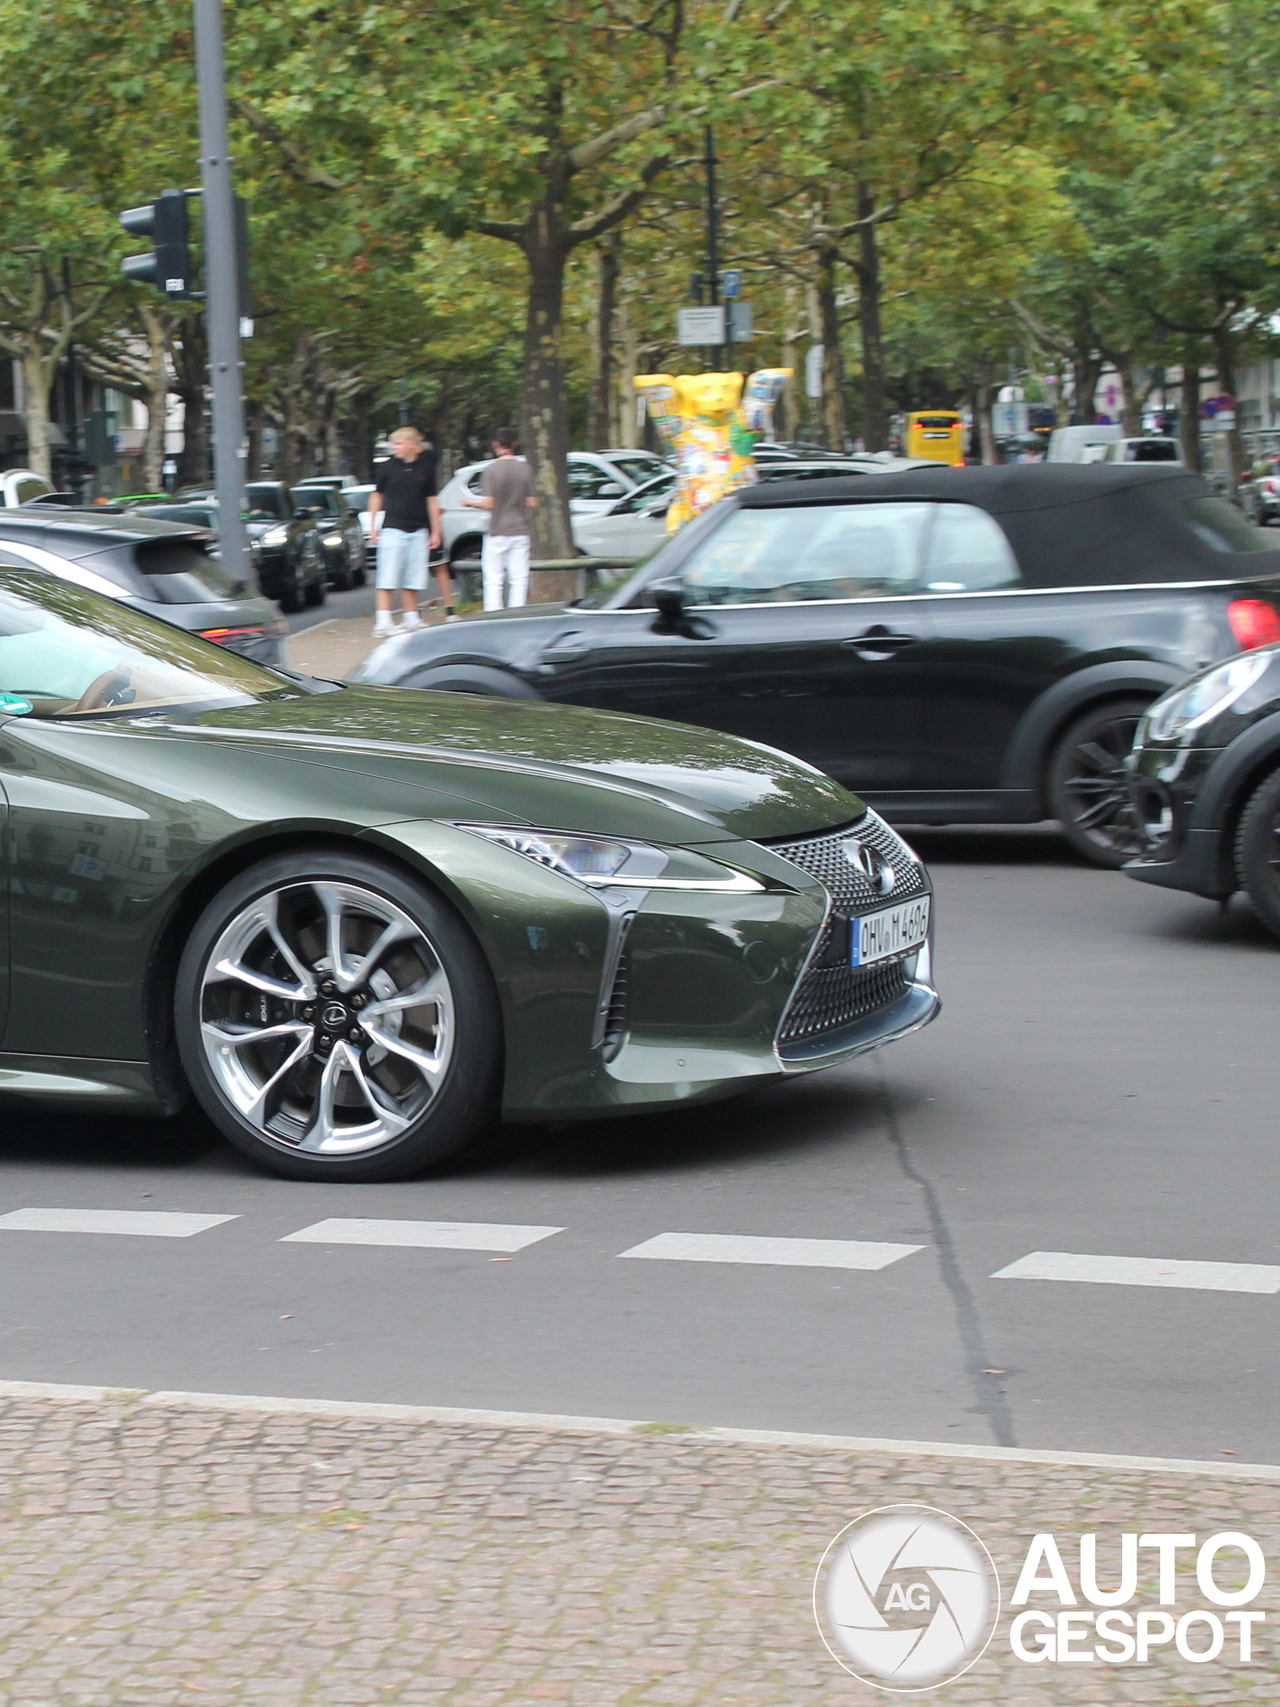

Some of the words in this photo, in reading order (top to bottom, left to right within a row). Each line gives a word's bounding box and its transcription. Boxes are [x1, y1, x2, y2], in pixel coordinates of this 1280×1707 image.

[862, 916, 885, 958] OHV
[892, 911, 900, 949] M
[902, 902, 928, 943] 4696
